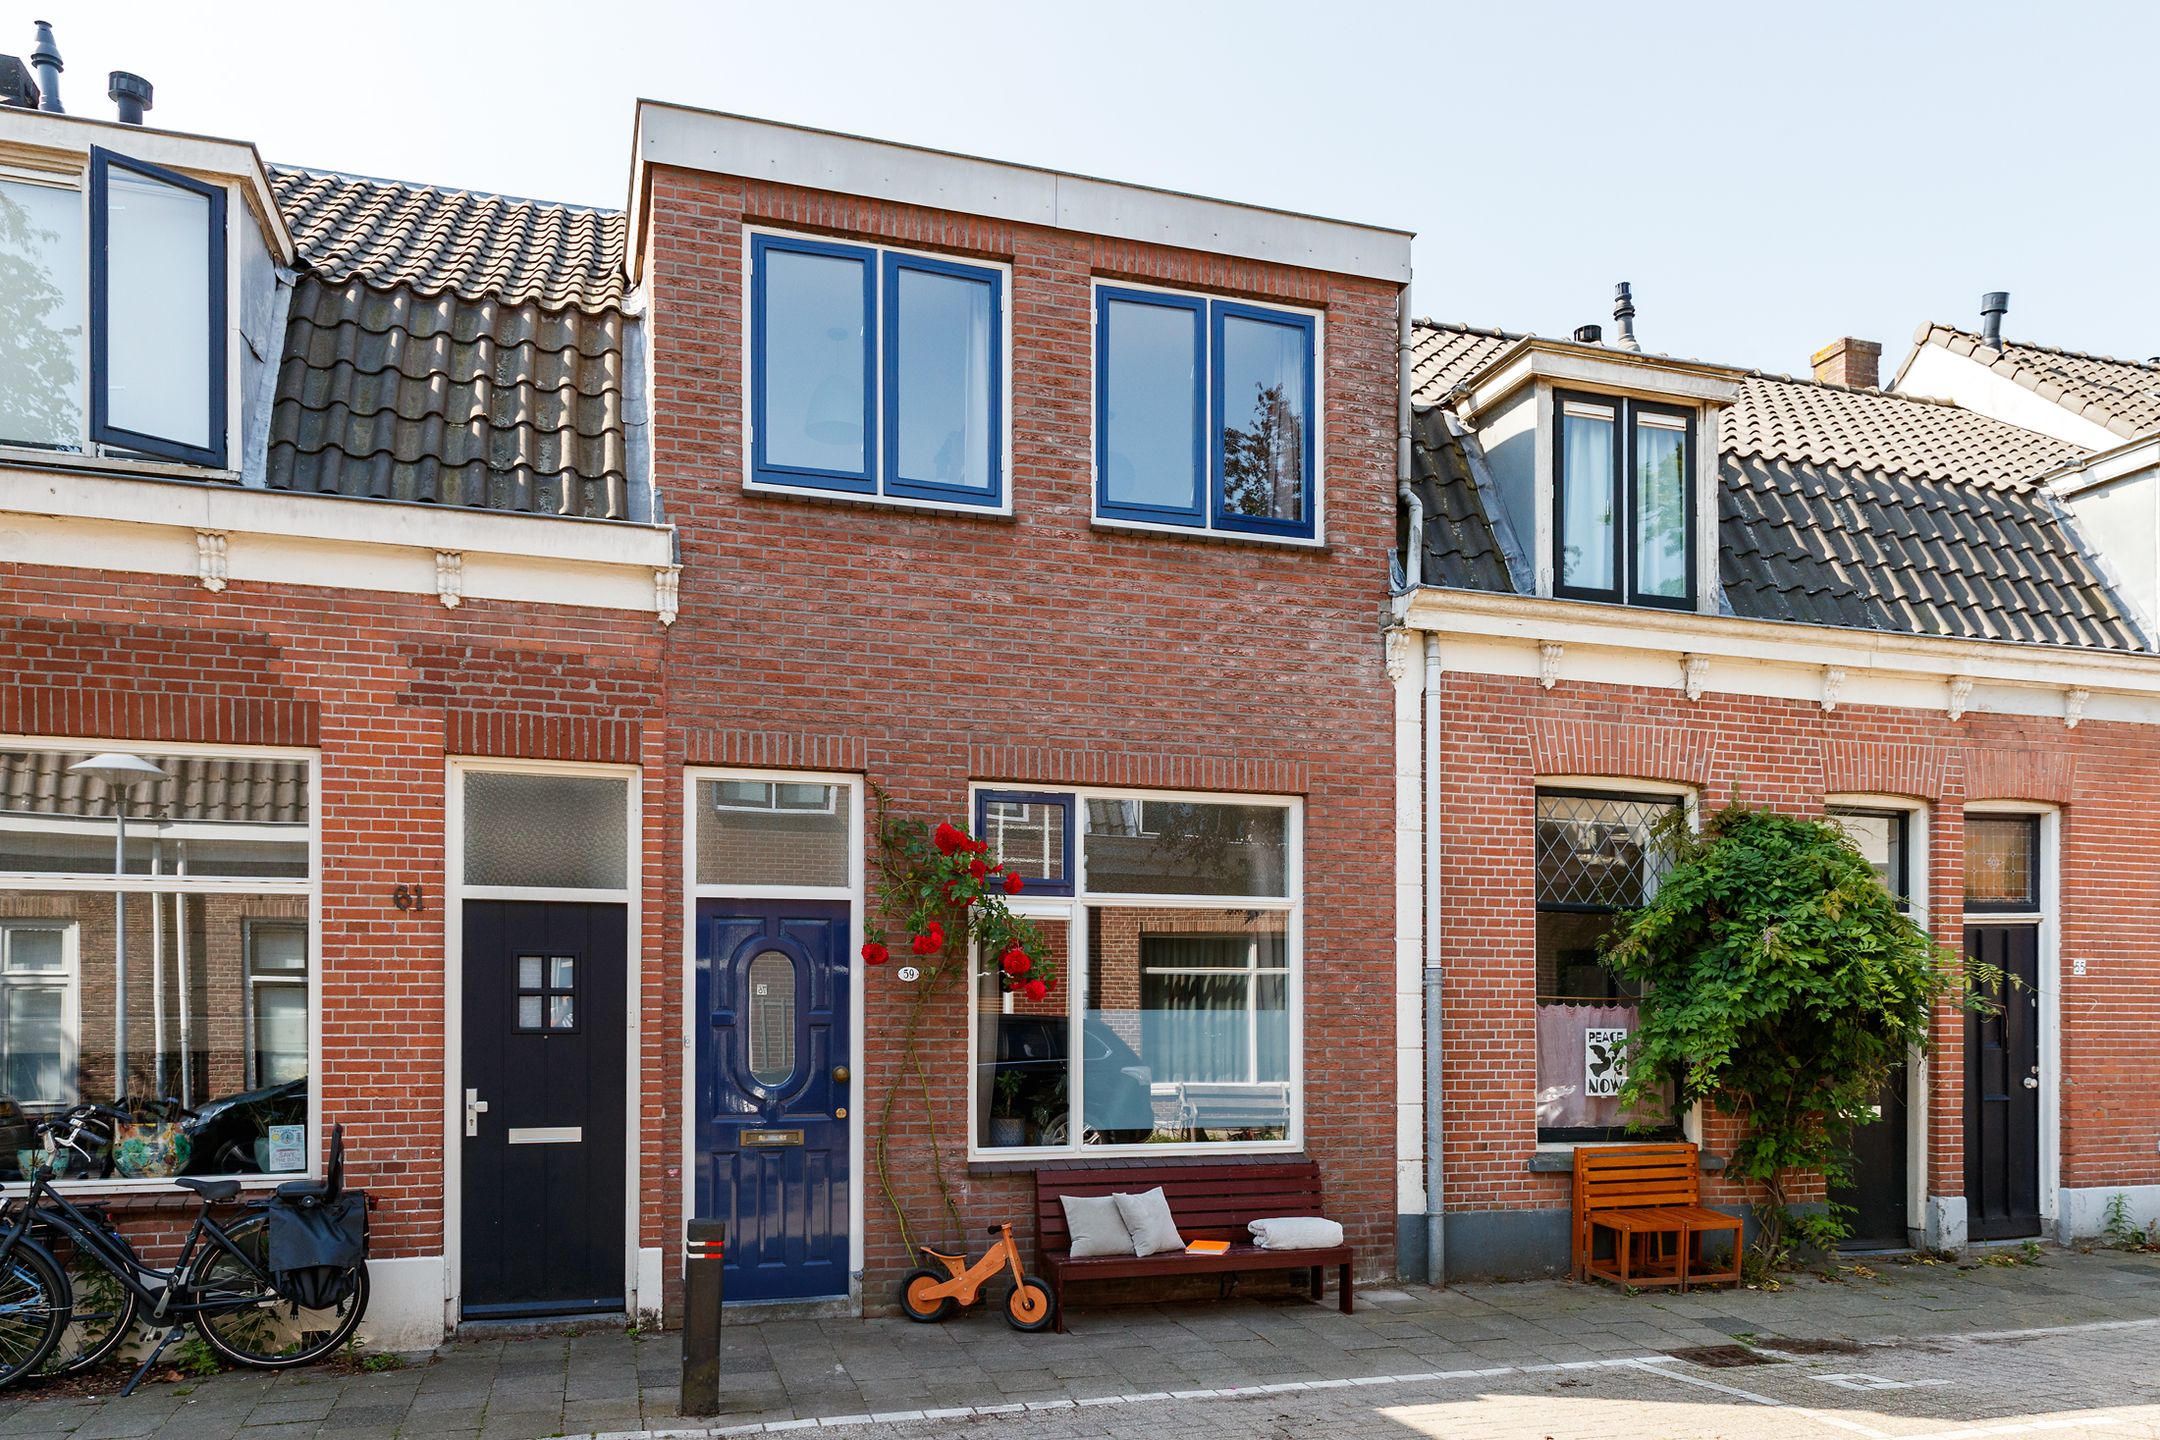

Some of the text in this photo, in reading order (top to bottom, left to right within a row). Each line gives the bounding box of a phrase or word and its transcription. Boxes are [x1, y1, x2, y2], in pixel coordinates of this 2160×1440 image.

[393, 885, 423, 911] 61
[2075, 961, 2085, 973] 55
[903, 969, 915, 979] 59
[1588, 1031, 1624, 1043] PEACE
[1588, 1078, 1625, 1094] NOW
